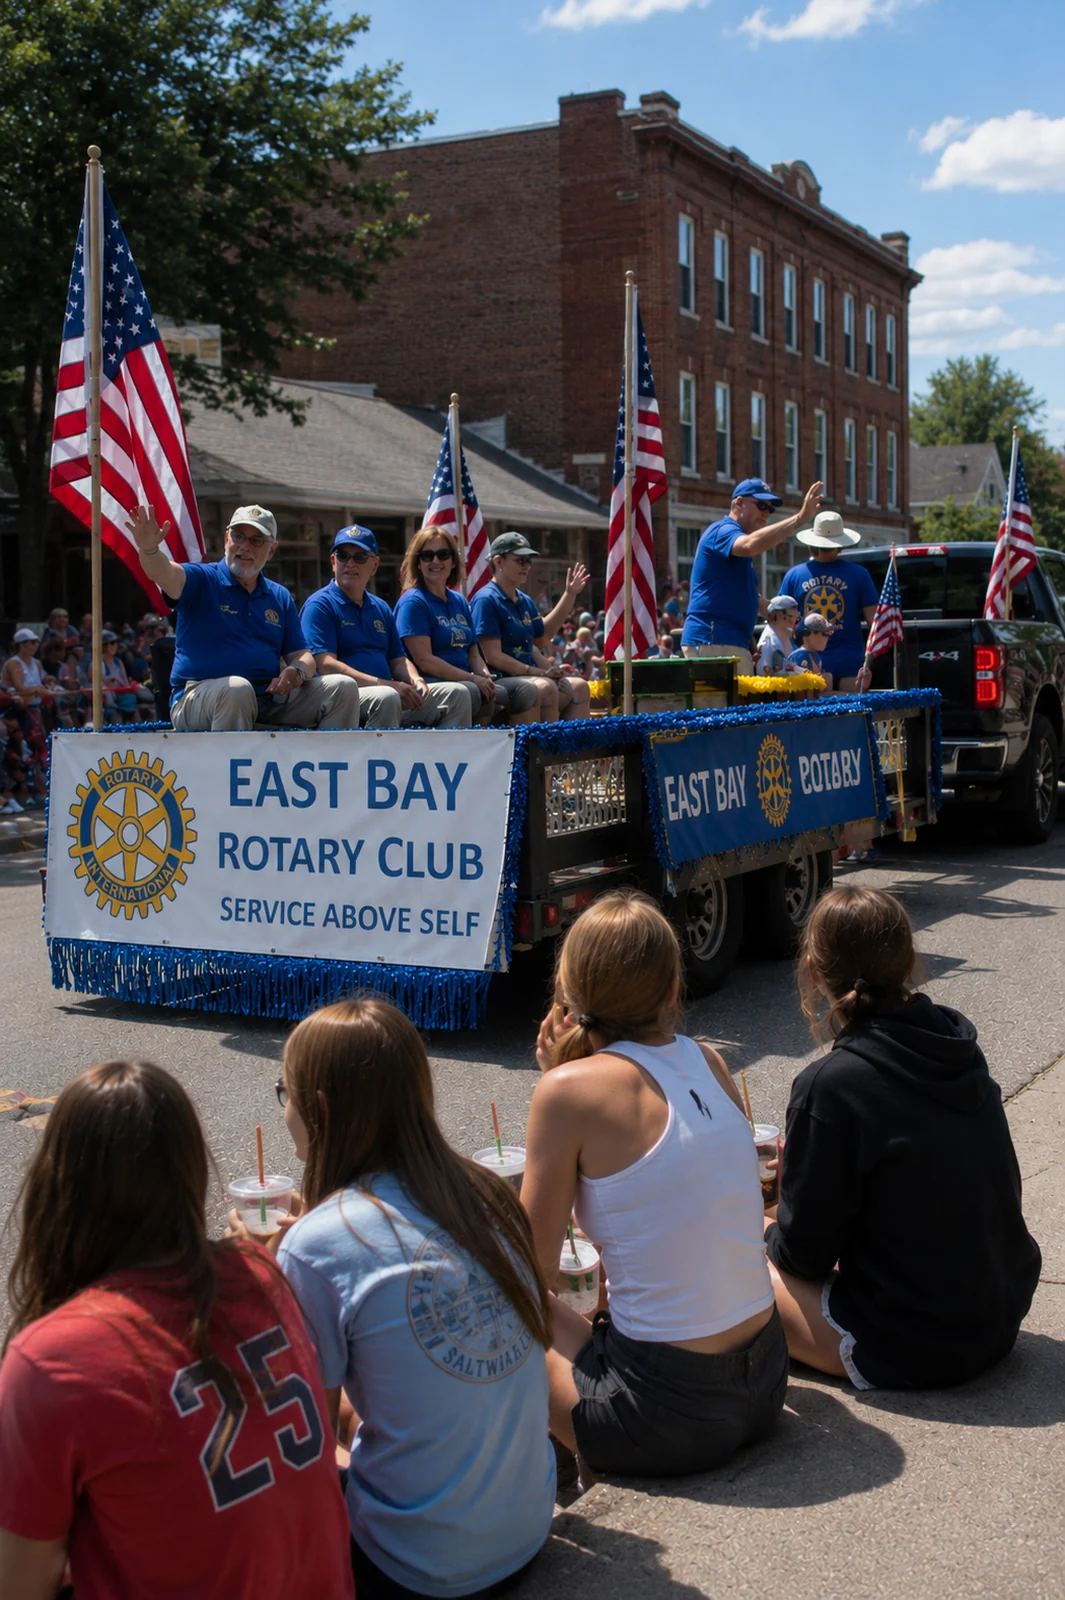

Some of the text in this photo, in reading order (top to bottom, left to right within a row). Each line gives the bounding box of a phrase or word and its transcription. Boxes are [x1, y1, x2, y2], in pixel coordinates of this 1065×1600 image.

[105, 769, 158, 789] ROTARY
[229, 758, 467, 811] EAST BAY
[664, 771, 710, 821] EAST
[714, 766, 747, 812] BAY
[219, 832, 484, 880] ROTARY CLUB
[220, 897, 480, 937] SERVICE ABOVE SELF
[170, 1324, 325, 1513] 25
